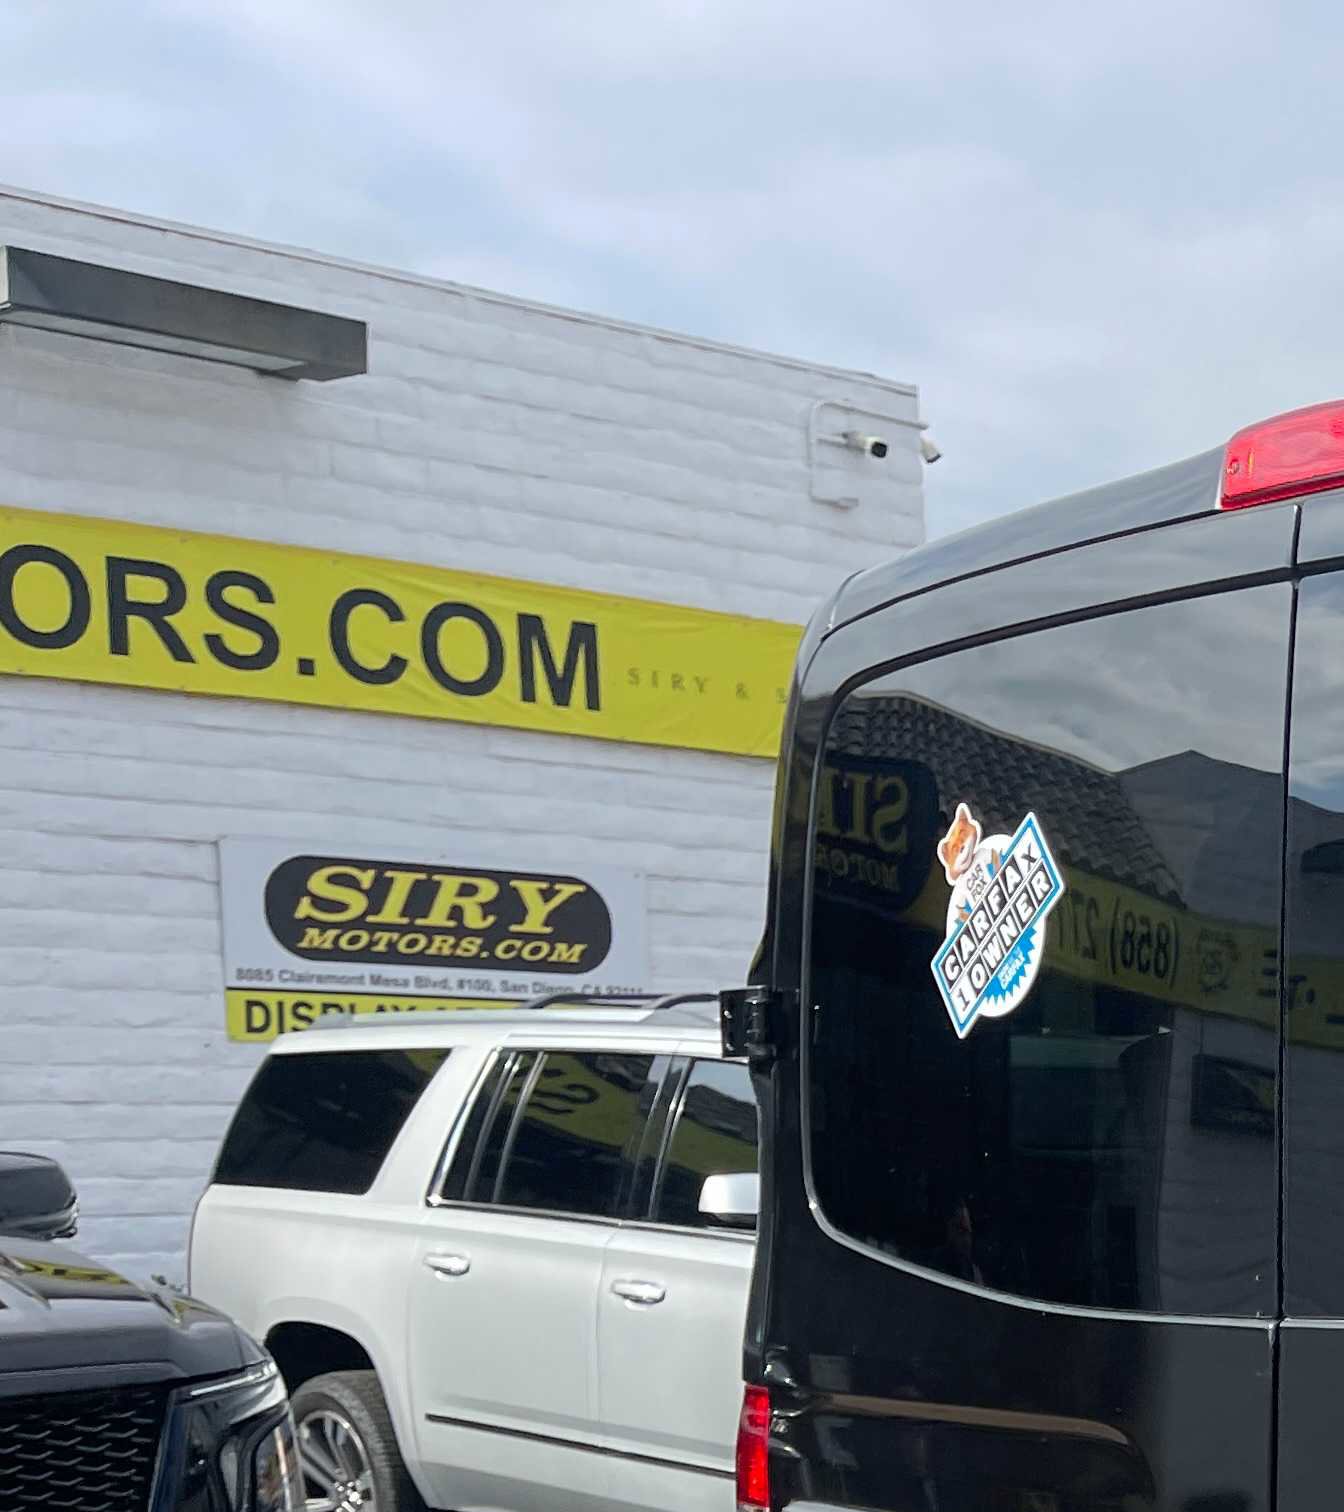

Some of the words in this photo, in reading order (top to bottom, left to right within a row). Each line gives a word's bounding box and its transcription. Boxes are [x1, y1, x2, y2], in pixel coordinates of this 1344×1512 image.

[0, 543, 601, 711] ORS.COM
[293, 865, 584, 938] SIRY
[296, 926, 590, 966] MOTORS.COM
[944, 844, 1037, 981] CARFAX
[956, 988, 970, 1011] 1
[970, 871, 1050, 990] OWNER
